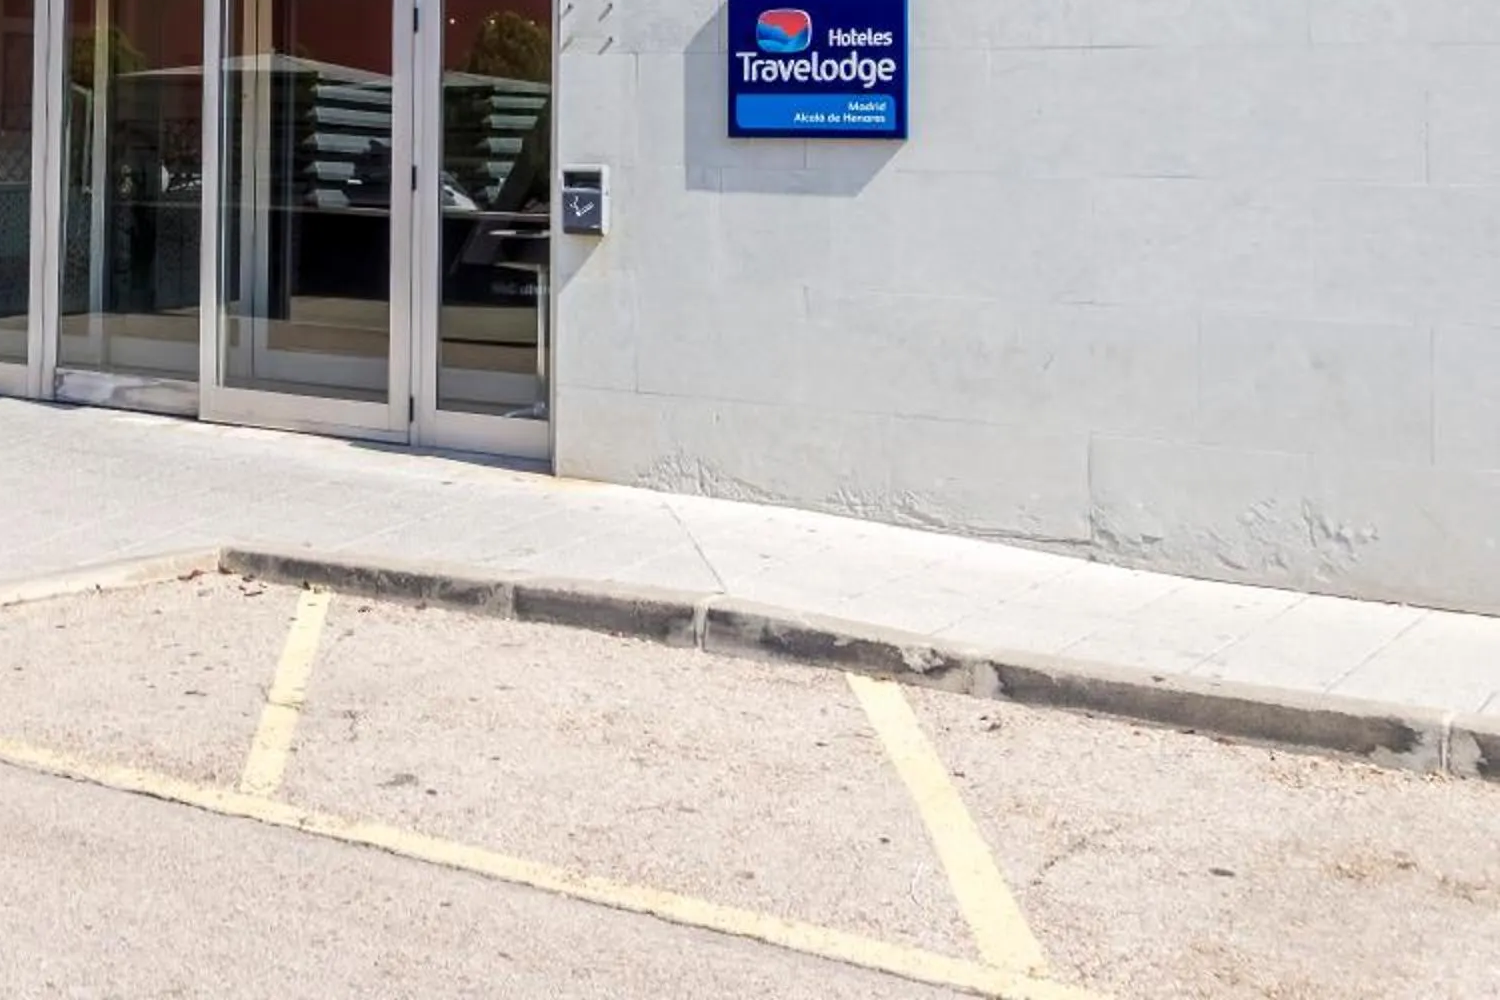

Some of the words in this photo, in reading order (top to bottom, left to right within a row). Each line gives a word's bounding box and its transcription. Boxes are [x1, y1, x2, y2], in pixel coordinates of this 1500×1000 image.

[828, 27, 892, 46] Hoteles
[735, 50, 897, 89] Travelodge
[848, 101, 886, 111] Madrid
[827, 113, 841, 123] de
[843, 113, 886, 123] Henares
